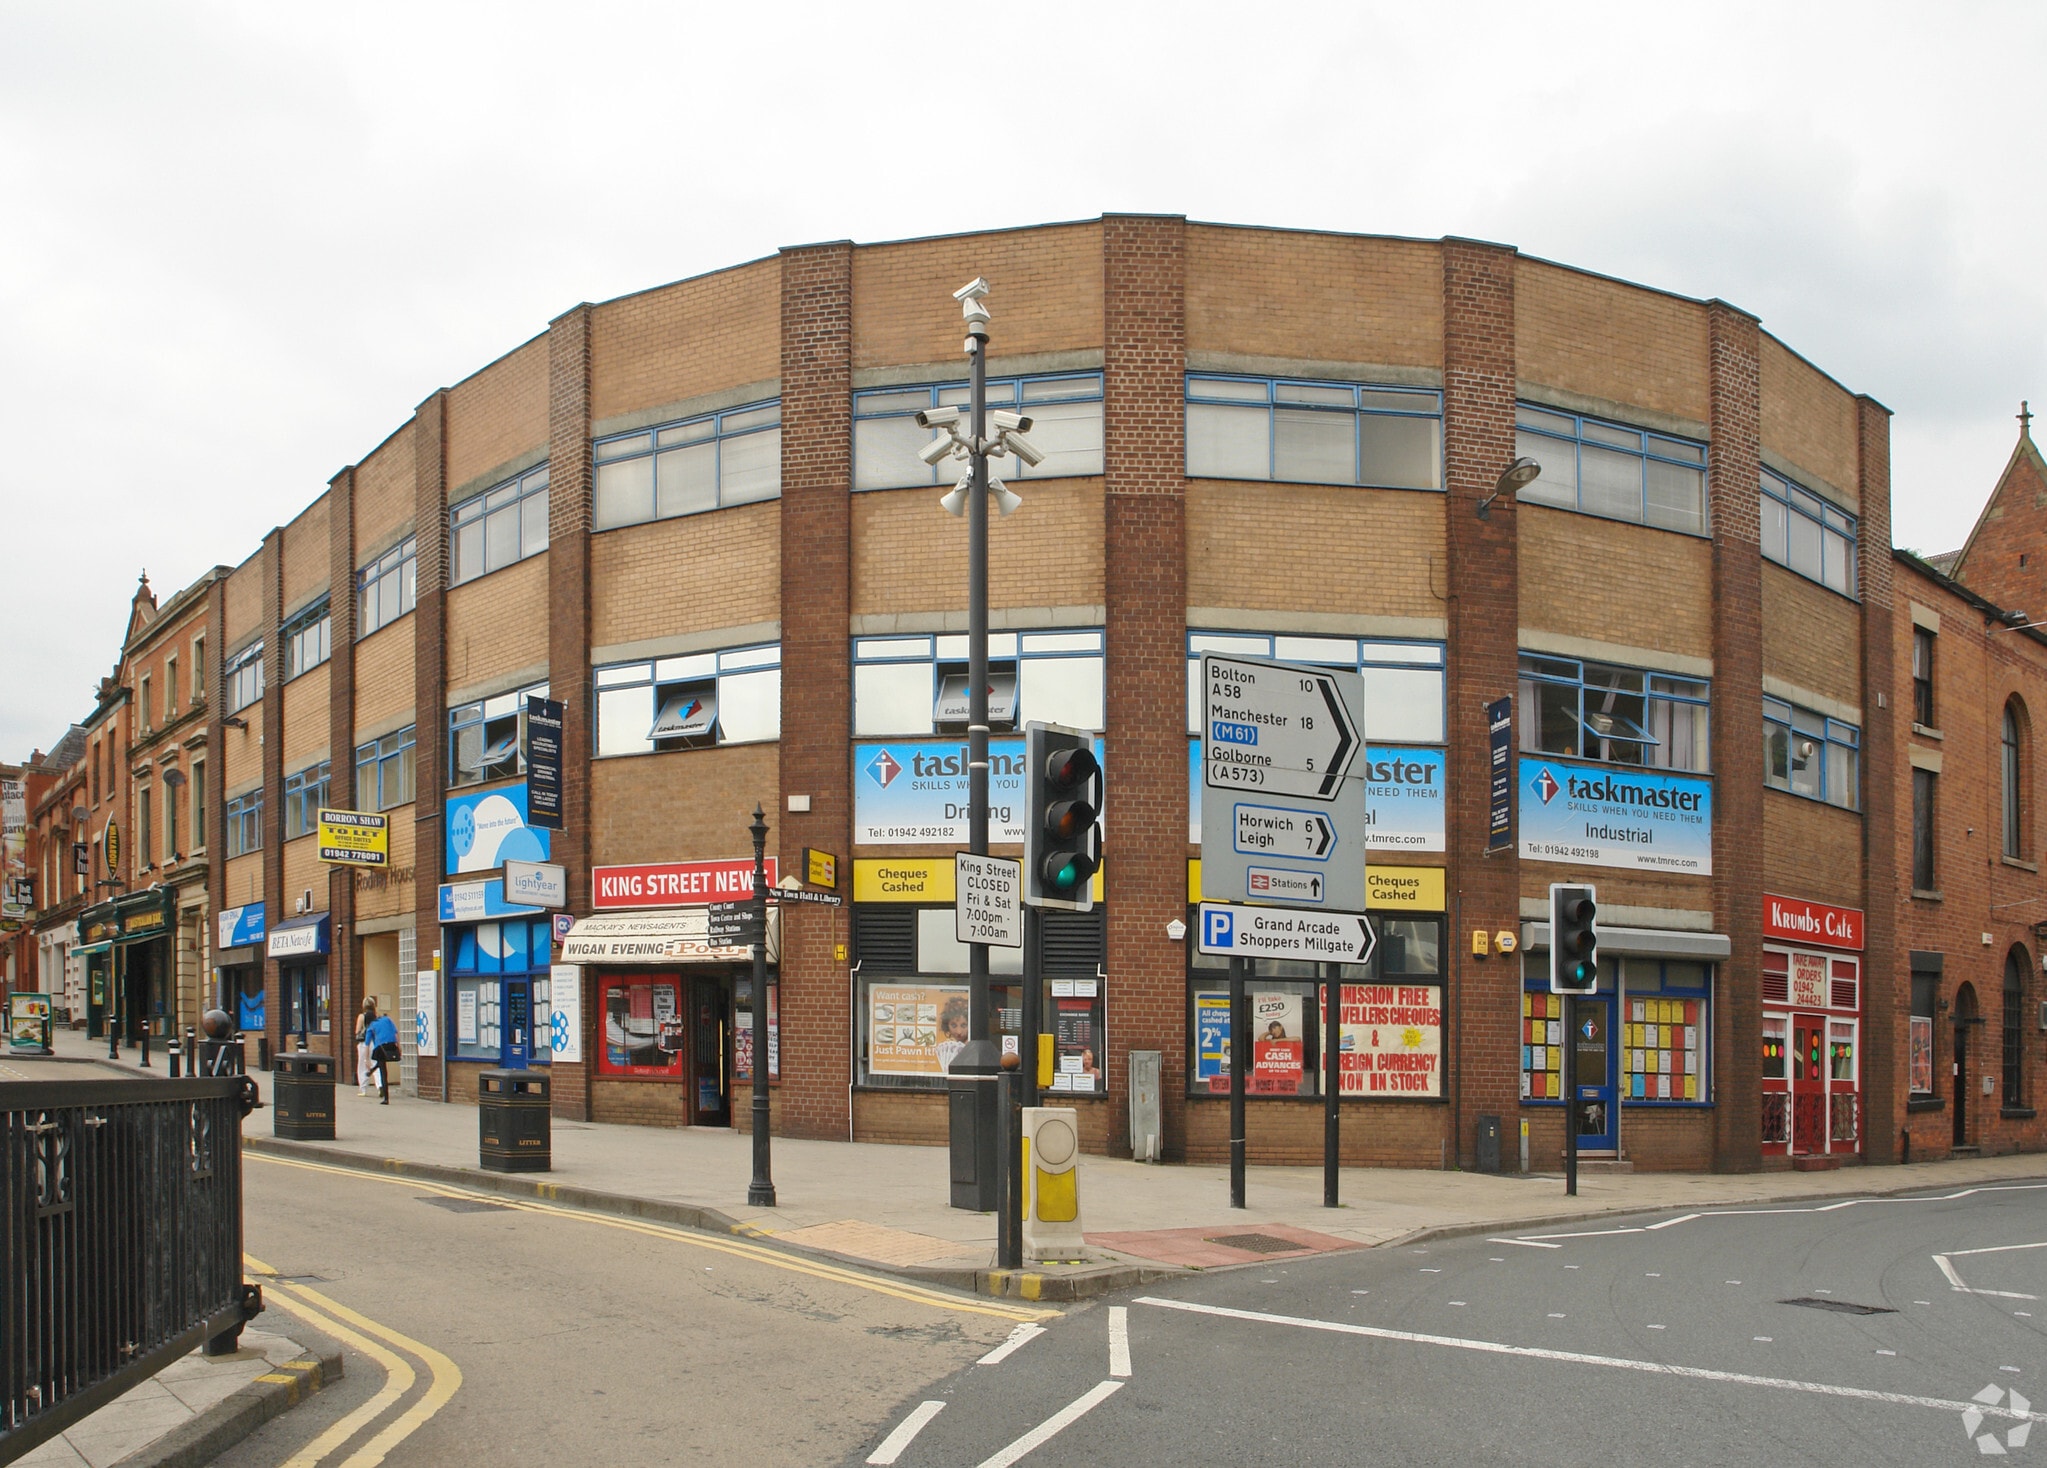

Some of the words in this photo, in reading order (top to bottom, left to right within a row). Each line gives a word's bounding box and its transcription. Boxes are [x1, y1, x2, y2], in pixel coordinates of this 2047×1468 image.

[1211, 665, 1256, 684] Bolton
[1299, 680, 1313, 692] 10
[1212, 704, 1288, 726] Manchester
[1300, 717, 1314, 730] 18
[1212, 747, 1272, 766] Golborne
[1306, 758, 1314, 771] 5
[912, 781, 950, 790] SKILLS
[996, 780, 1018, 789] YOU
[1368, 787, 1400, 797] NEED
[1406, 788, 1438, 798] THEM
[1568, 774, 1702, 812] taskmaster
[325, 813, 358, 824] BORRON
[360, 816, 381, 826] SHAW
[945, 803, 1011, 823] Dring
[1568, 802, 1598, 814] SKILLS
[1602, 806, 1628, 816] WHEN
[1632, 808, 1649, 818] YOU
[1653, 811, 1676, 822] NEED
[1680, 814, 1702, 824] THEM
[1240, 813, 1294, 831] Horwich
[1305, 820, 1313, 833] 6
[353, 829, 380, 837] LET
[868, 828, 885, 837] Tel:
[888, 828, 917, 837] 01942
[920, 827, 954, 837] 492182
[1586, 822, 1653, 844] Industrial
[1240, 832, 1274, 848] Leigh
[1305, 838, 1313, 850] 7
[325, 849, 349, 858] 01942
[352, 851, 380, 861] 776091
[1528, 844, 1542, 854] Tel:
[1545, 845, 1569, 856] 01942
[1571, 848, 1599, 858] 492198
[1637, 855, 1698, 868] www.tmrec.com
[878, 869, 927, 883] Cheques
[960, 860, 981, 875] King
[986, 864, 1016, 879] Street
[515, 876, 558, 891] lightyear
[601, 876, 642, 897] KING
[646, 872, 711, 896] STREET
[882, 882, 924, 892] Cashed
[967, 877, 1010, 893] CLOSED
[1271, 877, 1308, 890] Stations
[1368, 876, 1420, 888] Cheques
[783, 890, 798, 899] Town
[800, 892, 813, 900] Hall
[814, 893, 819, 901] &
[820, 894, 841, 906] Library
[967, 893, 980, 906] Fri
[984, 896, 990, 906] &
[995, 897, 1011, 910] Sat
[1372, 890, 1416, 900] Cashed
[966, 908, 1003, 924] 7:00pm
[627, 922, 687, 930] NEWSAGENTS
[971, 925, 1008, 939] 7:00am
[1211, 914, 1230, 945] P
[1254, 917, 1292, 932] Grand
[1298, 920, 1340, 935] Arcade
[272, 936, 289, 949] BETA
[568, 944, 606, 954] WIGAN
[611, 943, 664, 955] EVENING
[676, 942, 734, 954] Post
[1240, 933, 1300, 949] Shoppers
[1305, 937, 1354, 953] Millgate
[1796, 968, 1822, 982] ORDERS
[1794, 981, 1814, 993] 01942
[875, 991, 900, 1000] Want
[902, 992, 926, 1000] cash?
[1399, 988, 1429, 1006] FREE
[1259, 1002, 1285, 1013] £250
[1390, 1008, 1440, 1026] CHEQUES
[1202, 1027, 1221, 1048] 2%
[1372, 1029, 1379, 1047] &
[874, 1046, 893, 1055] Just
[896, 1047, 922, 1056] Pawn
[1265, 1052, 1292, 1060] CASH
[1377, 1054, 1437, 1072] CURRENCY
[1340, 1073, 1363, 1091] NOW
[1370, 1073, 1386, 1091] IN
[1390, 1073, 1429, 1091] STOCK
